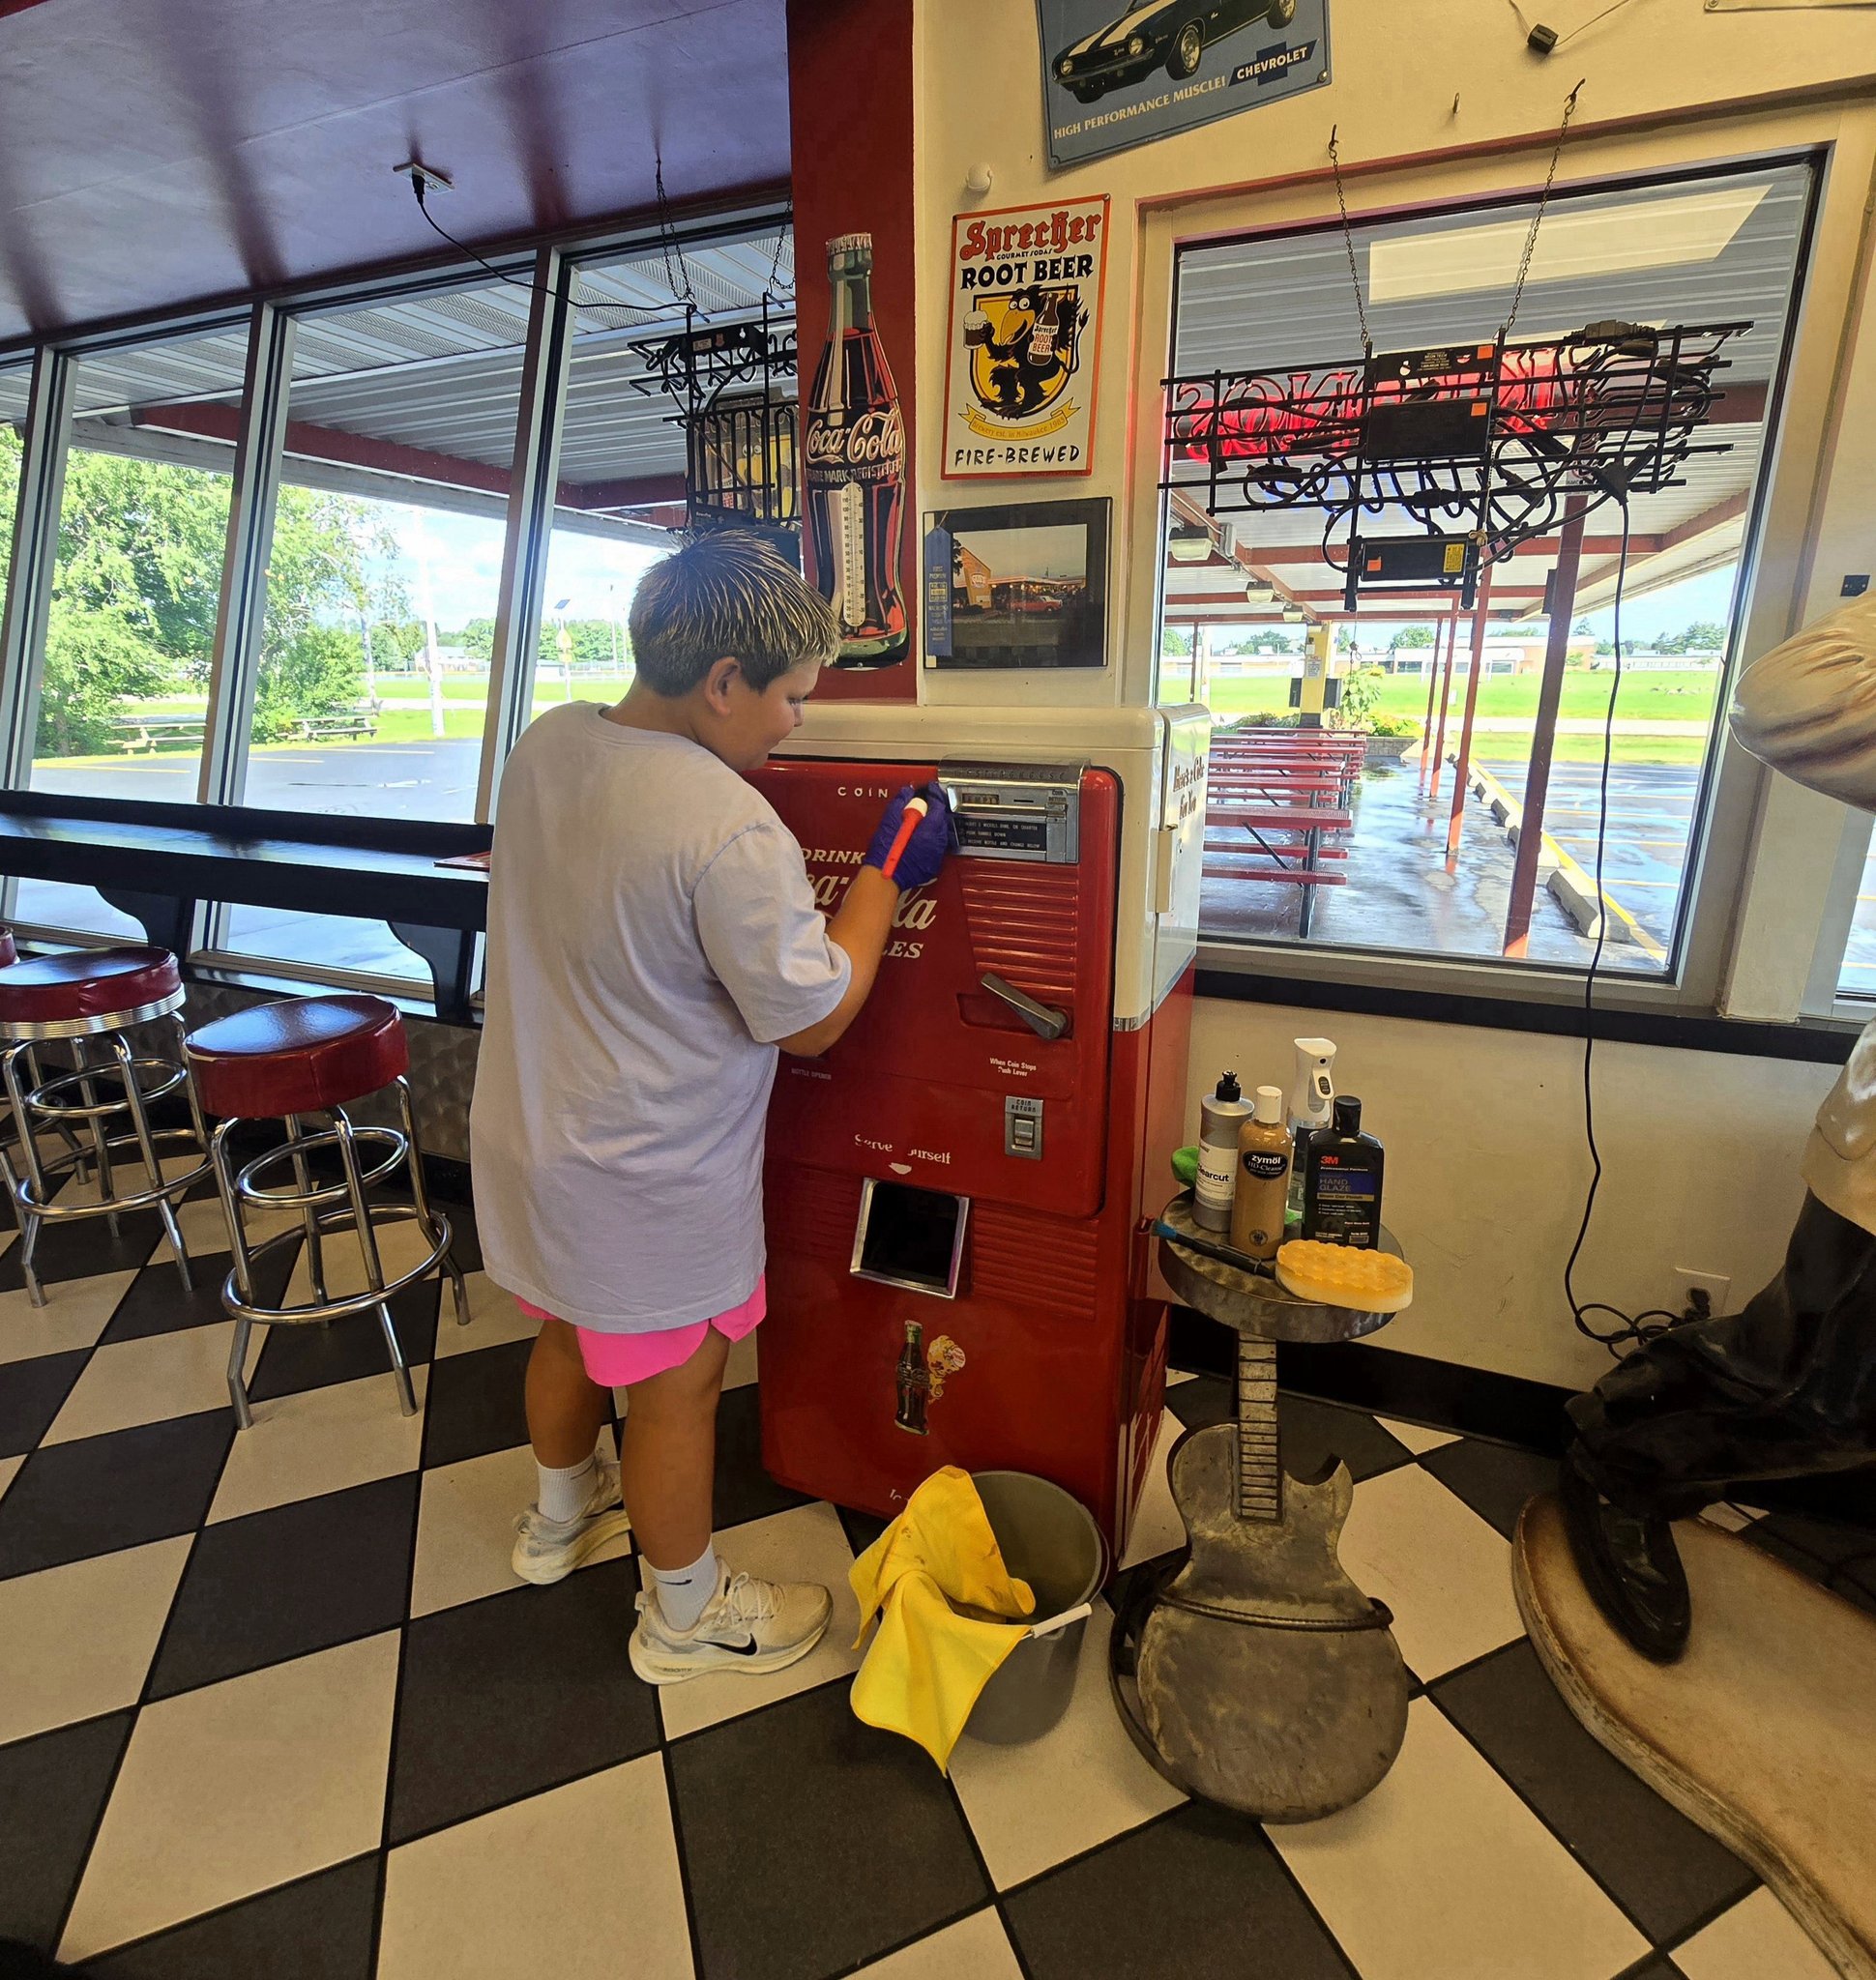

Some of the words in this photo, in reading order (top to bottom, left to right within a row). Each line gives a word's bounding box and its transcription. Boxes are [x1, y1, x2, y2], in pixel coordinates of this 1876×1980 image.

[1236, 46, 1308, 80] CHEVROLET
[1054, 121, 1081, 139] HIGH
[1084, 94, 1170, 131] PERFORMANCE
[1173, 75, 1226, 102] MUSCLE!
[959, 211, 1102, 262] Sprecher
[996, 250, 1029, 261] GOURMET
[1030, 248, 1053, 257] SODAS
[960, 260, 1028, 290] ROOT
[1034, 253, 1094, 284] BEER
[1035, 334, 1052, 343] ROOT
[1032, 343, 1050, 353] BEER
[806, 408, 902, 464] Coca-Cola
[954, 445, 1080, 467] FIRE-BREWED
[824, 469, 849, 483] MARK
[837, 786, 889, 799] COIN
[802, 848, 865, 864] DRINK
[989, 1058, 1006, 1066] When
[1007, 1060, 1019, 1068] Coin
[1021, 1062, 1037, 1071] Stops
[1012, 1068, 1028, 1077] Lever
[1011, 1104, 1037, 1113] RETURN
[1251, 1154, 1281, 1164] zymöl
[1320, 1155, 1339, 1165] 3M
